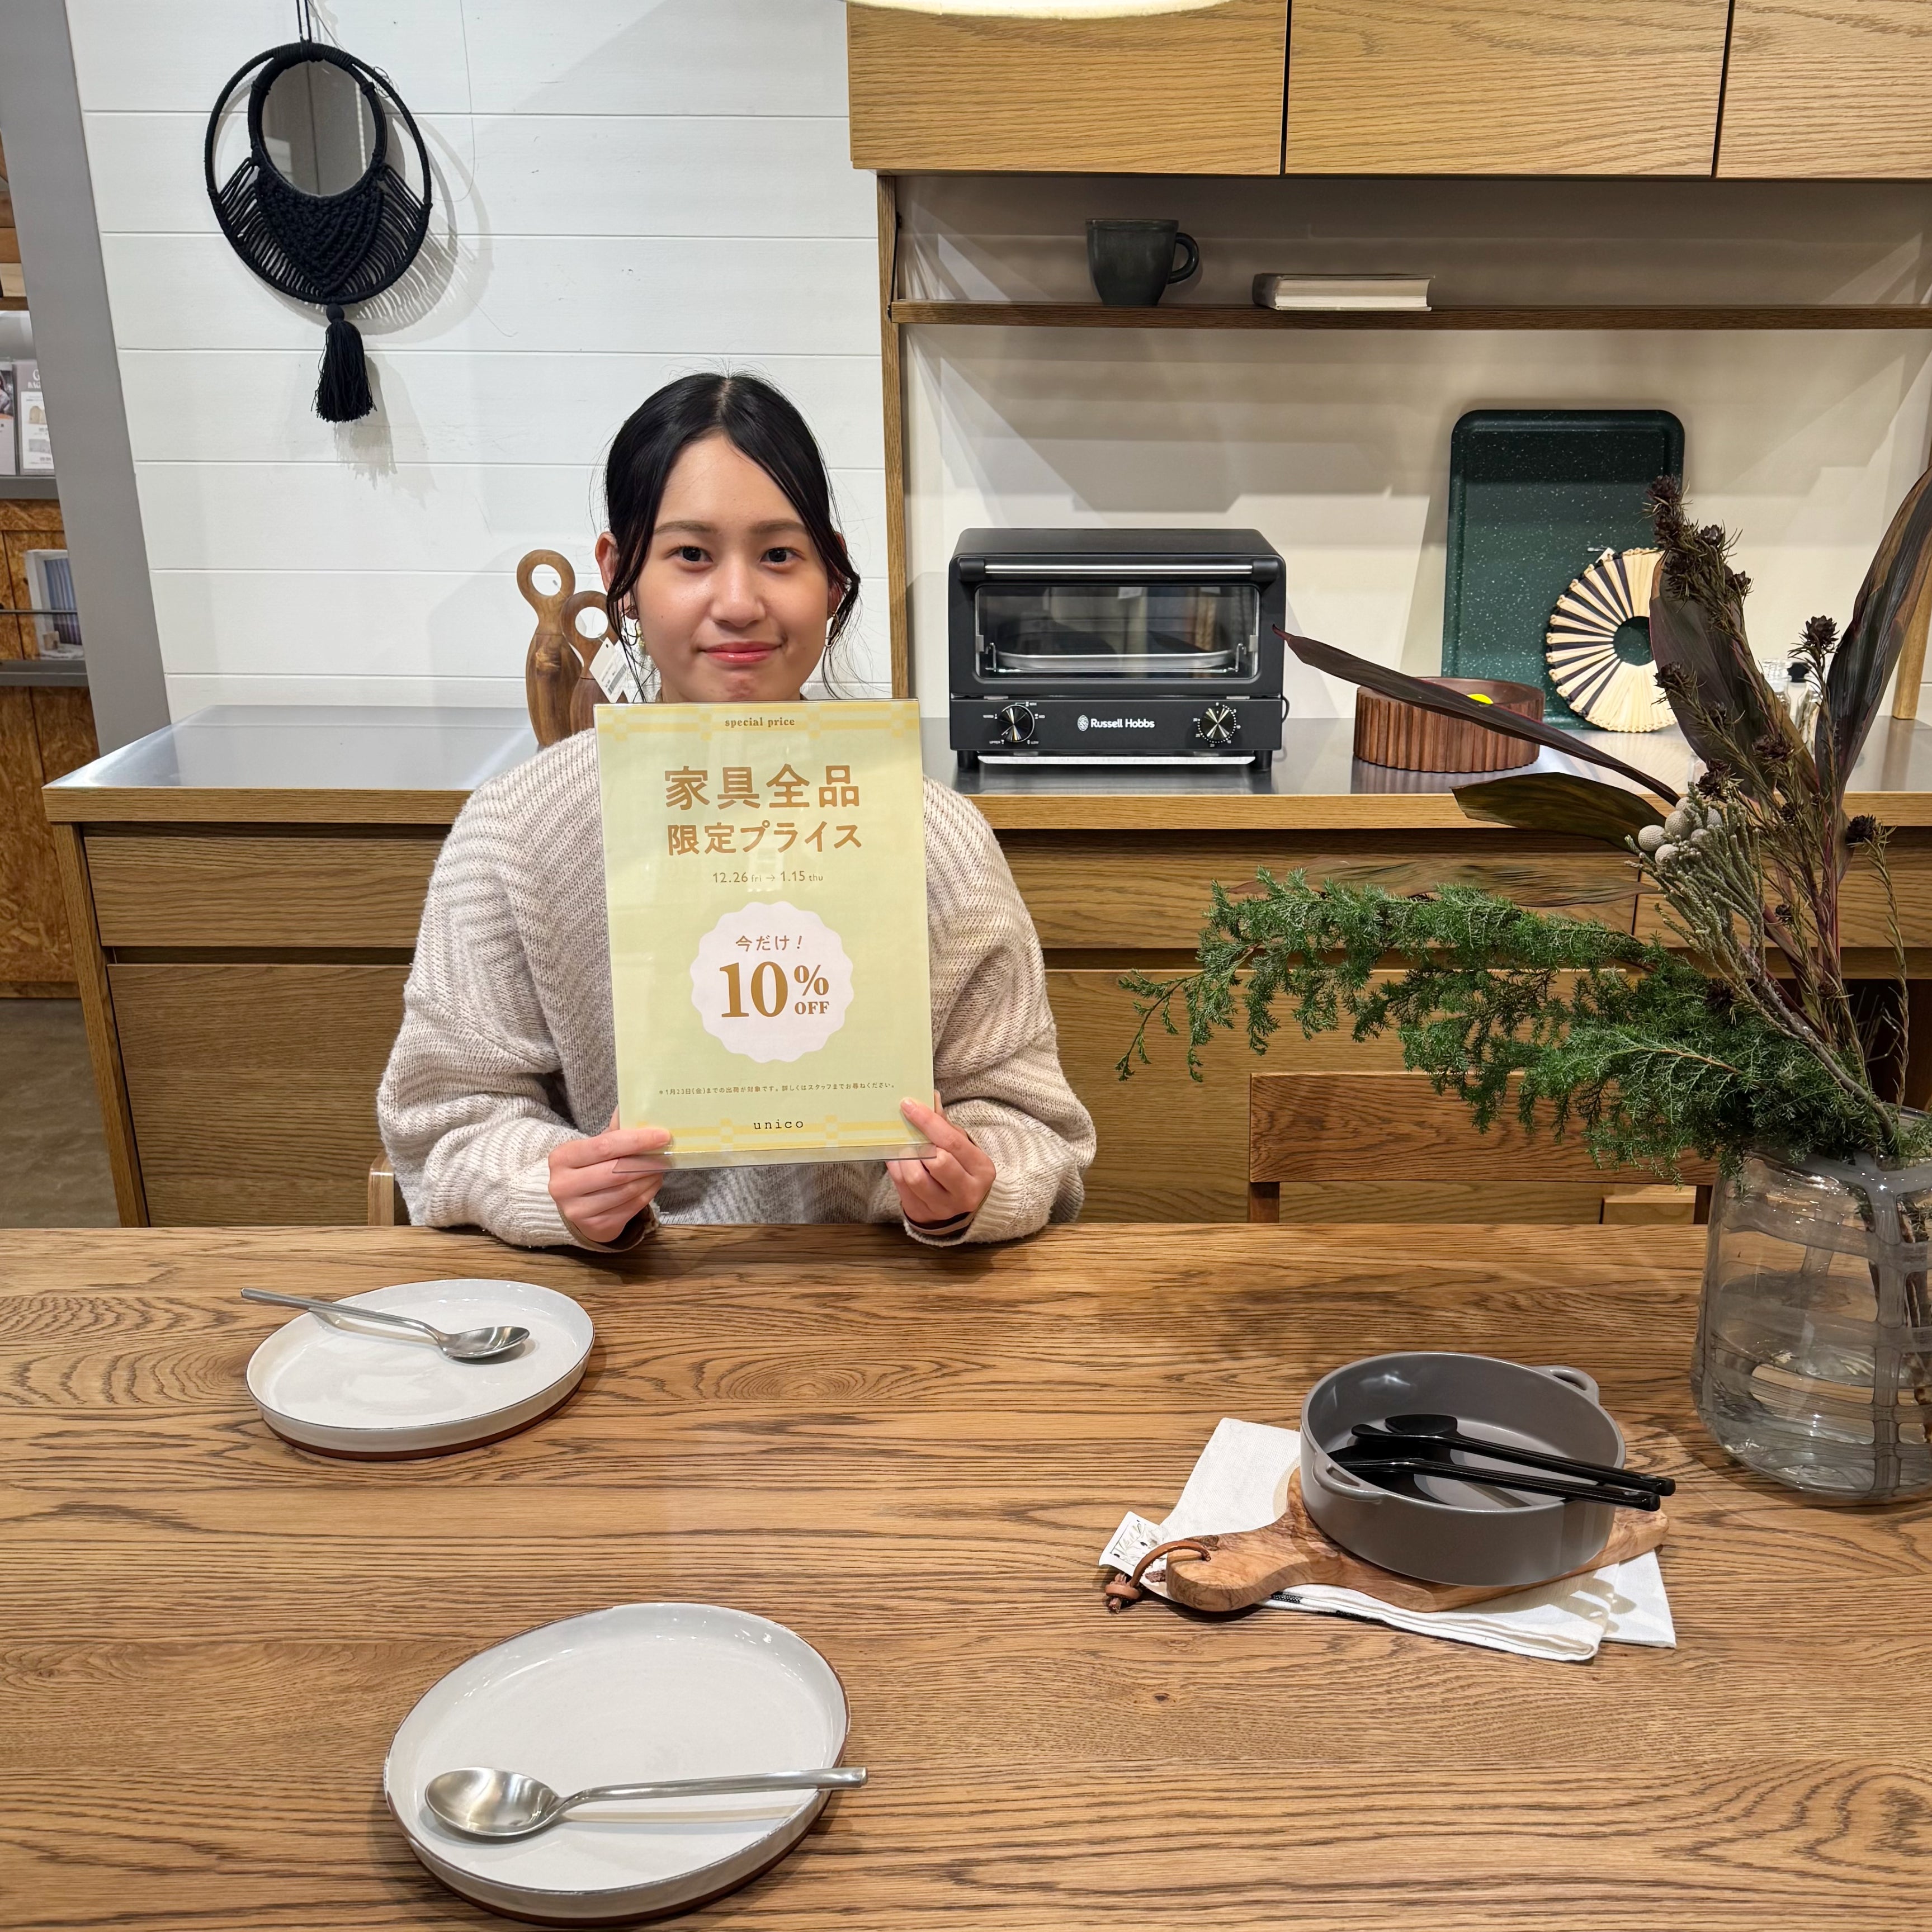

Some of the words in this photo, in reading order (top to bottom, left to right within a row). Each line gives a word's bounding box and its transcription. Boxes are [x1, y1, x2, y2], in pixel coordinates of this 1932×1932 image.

[725, 716, 763, 728] special
[768, 717, 795, 728] price
[1090, 718, 1123, 728] Russell
[1125, 718, 1155, 728] Hobbs
[664, 763, 859, 811] 家具全品
[667, 820, 862, 856] 限定プライス
[712, 872, 748, 884] 12.26
[751, 874, 762, 882] fri
[780, 870, 805, 882] 1.15
[794, 1001, 830, 1015] OFF
[753, 1119, 804, 1130] unico
